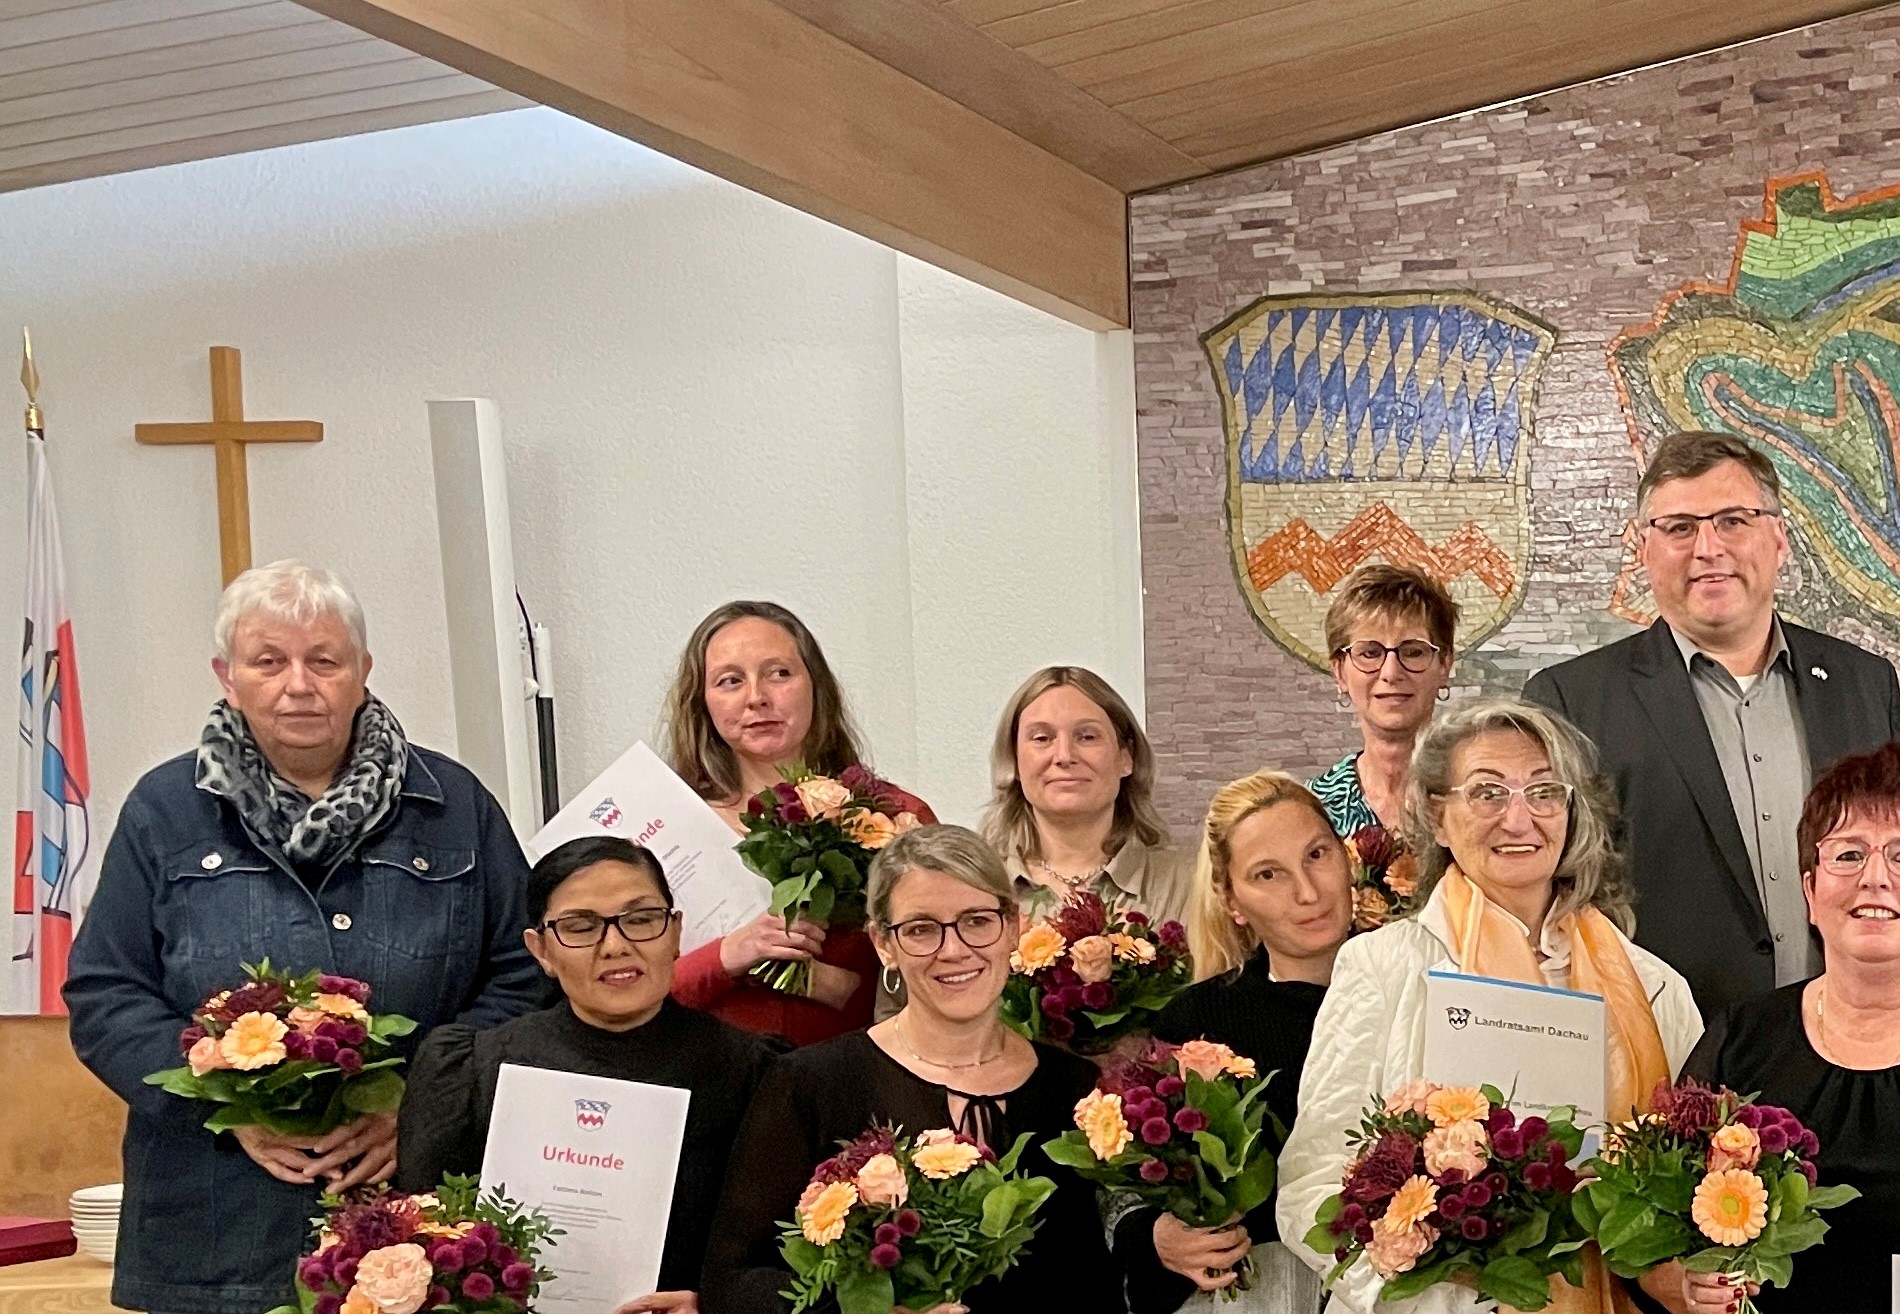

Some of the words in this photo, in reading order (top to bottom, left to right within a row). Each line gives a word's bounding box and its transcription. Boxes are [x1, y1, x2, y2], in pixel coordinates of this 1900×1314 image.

[1474, 1016, 1545, 1034] Landratsamt
[1548, 1026, 1589, 1041] Dachau
[543, 1145, 625, 1171] Urkunde
